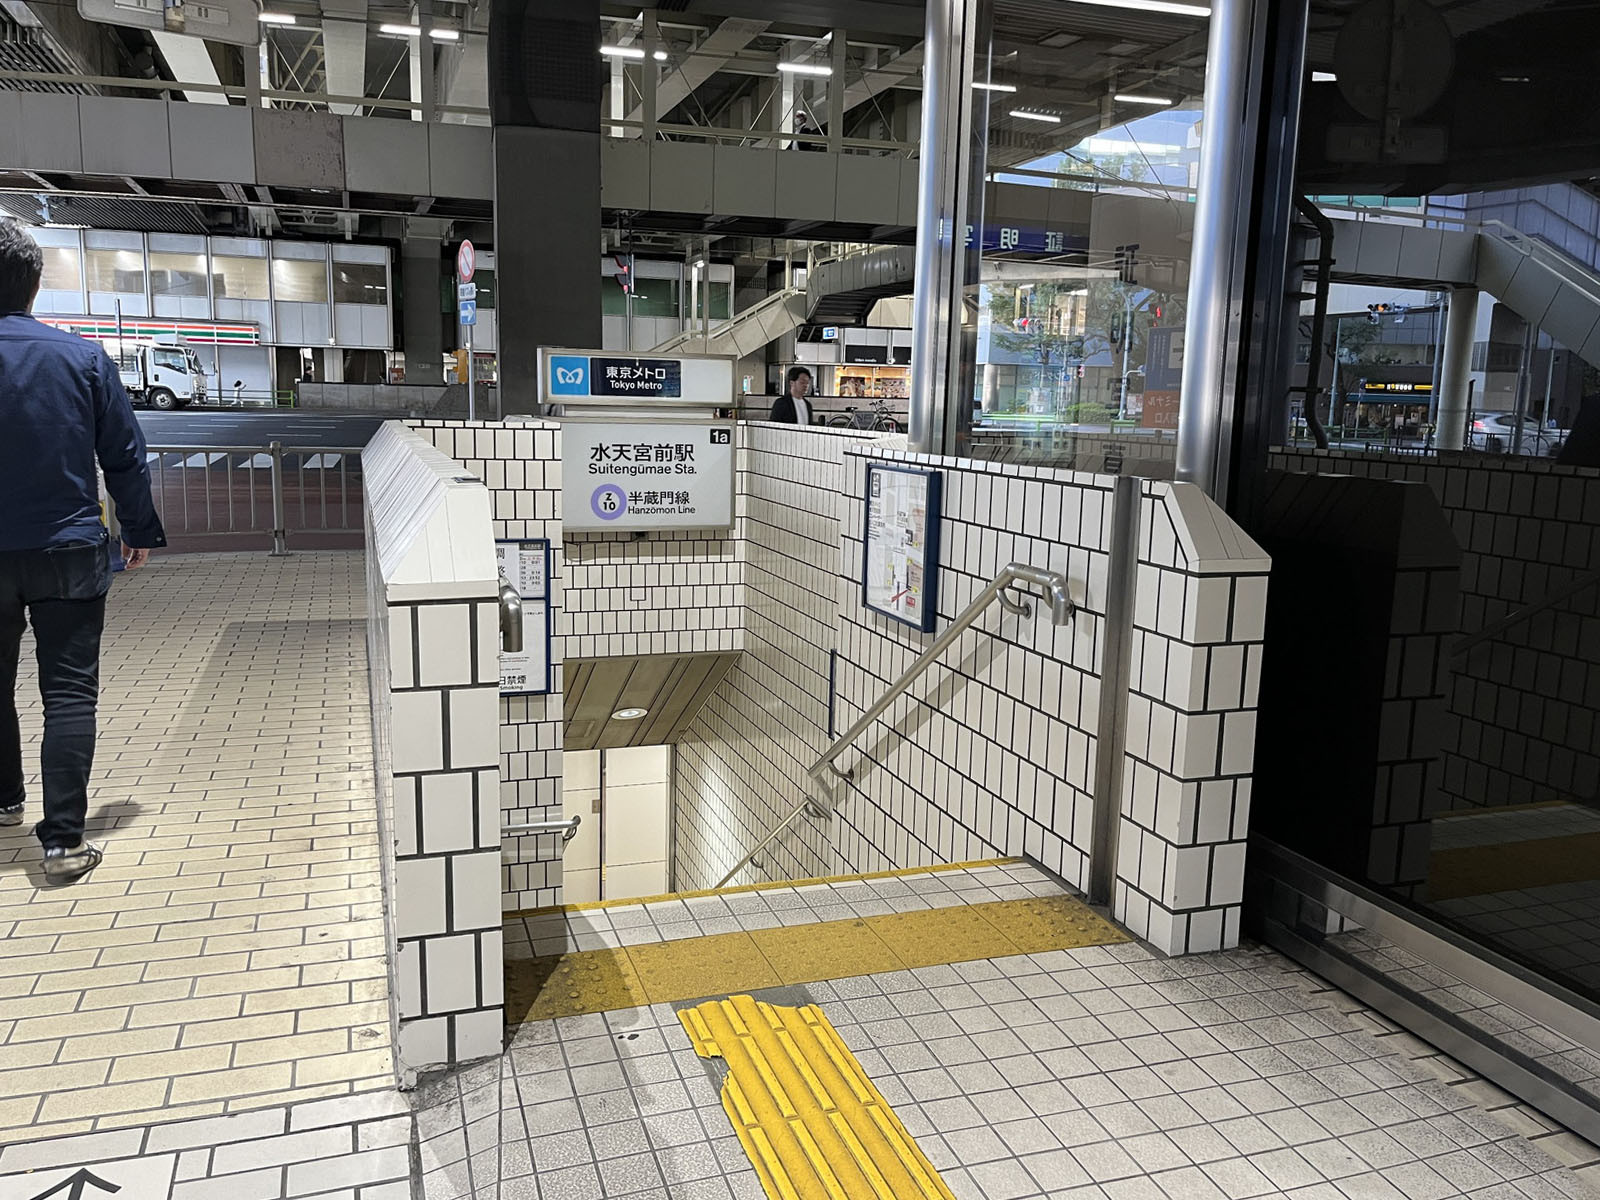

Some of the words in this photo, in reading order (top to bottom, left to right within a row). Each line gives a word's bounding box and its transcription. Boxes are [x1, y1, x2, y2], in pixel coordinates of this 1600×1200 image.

[606, 366, 666, 379] 東京メトロ
[610, 380, 635, 390] Tokyo
[637, 382, 663, 390] Metro
[712, 431, 728, 443] 1a
[590, 443, 695, 462] 水天宮前駅
[588, 463, 672, 476] Suitengūmae
[674, 464, 697, 474] Sta.
[605, 493, 612, 501] Z
[628, 491, 690, 505] 半蔵門線
[602, 503, 616, 511] 10
[628, 506, 676, 515] Hanzōmon
[678, 505, 696, 514] Line
